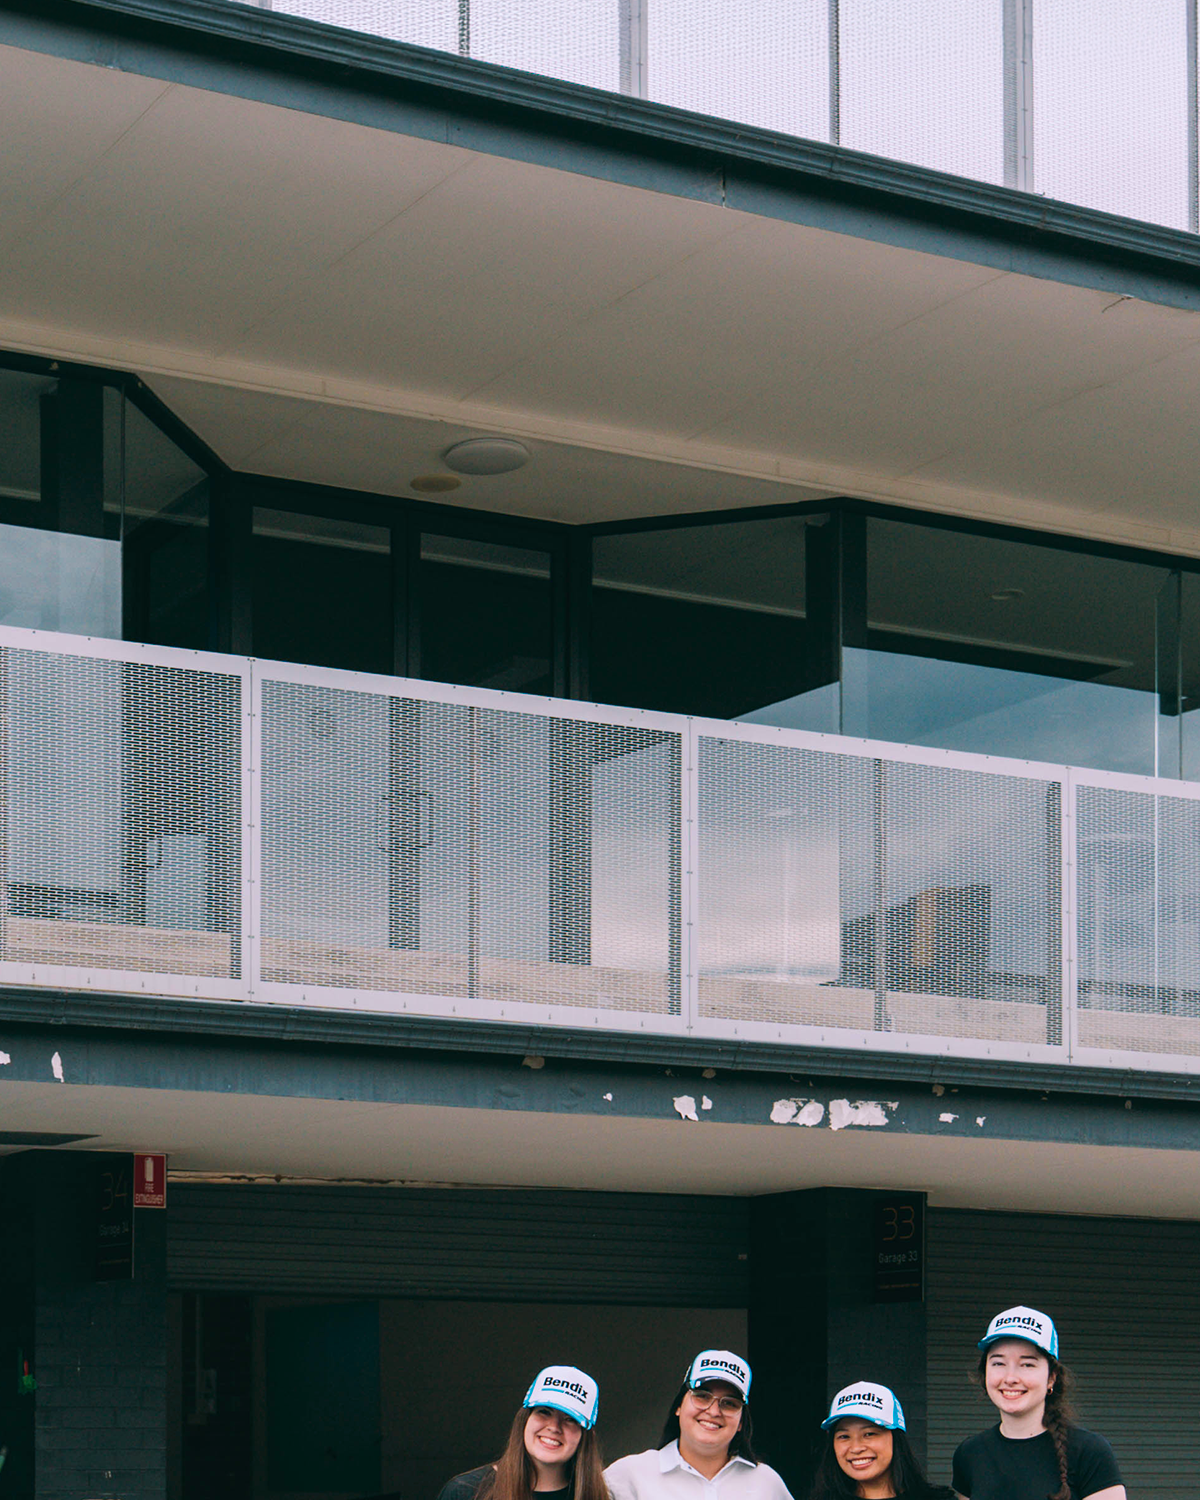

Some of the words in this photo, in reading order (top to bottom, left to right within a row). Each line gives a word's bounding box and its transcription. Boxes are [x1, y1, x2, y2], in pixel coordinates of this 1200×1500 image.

[882, 1205, 915, 1241] 33
[878, 1252, 907, 1265] Garage
[908, 1250, 918, 1262] 33
[995, 1316, 1042, 1331] Bendix
[543, 1376, 588, 1399] Bendix
[838, 1392, 883, 1406] Bendix
